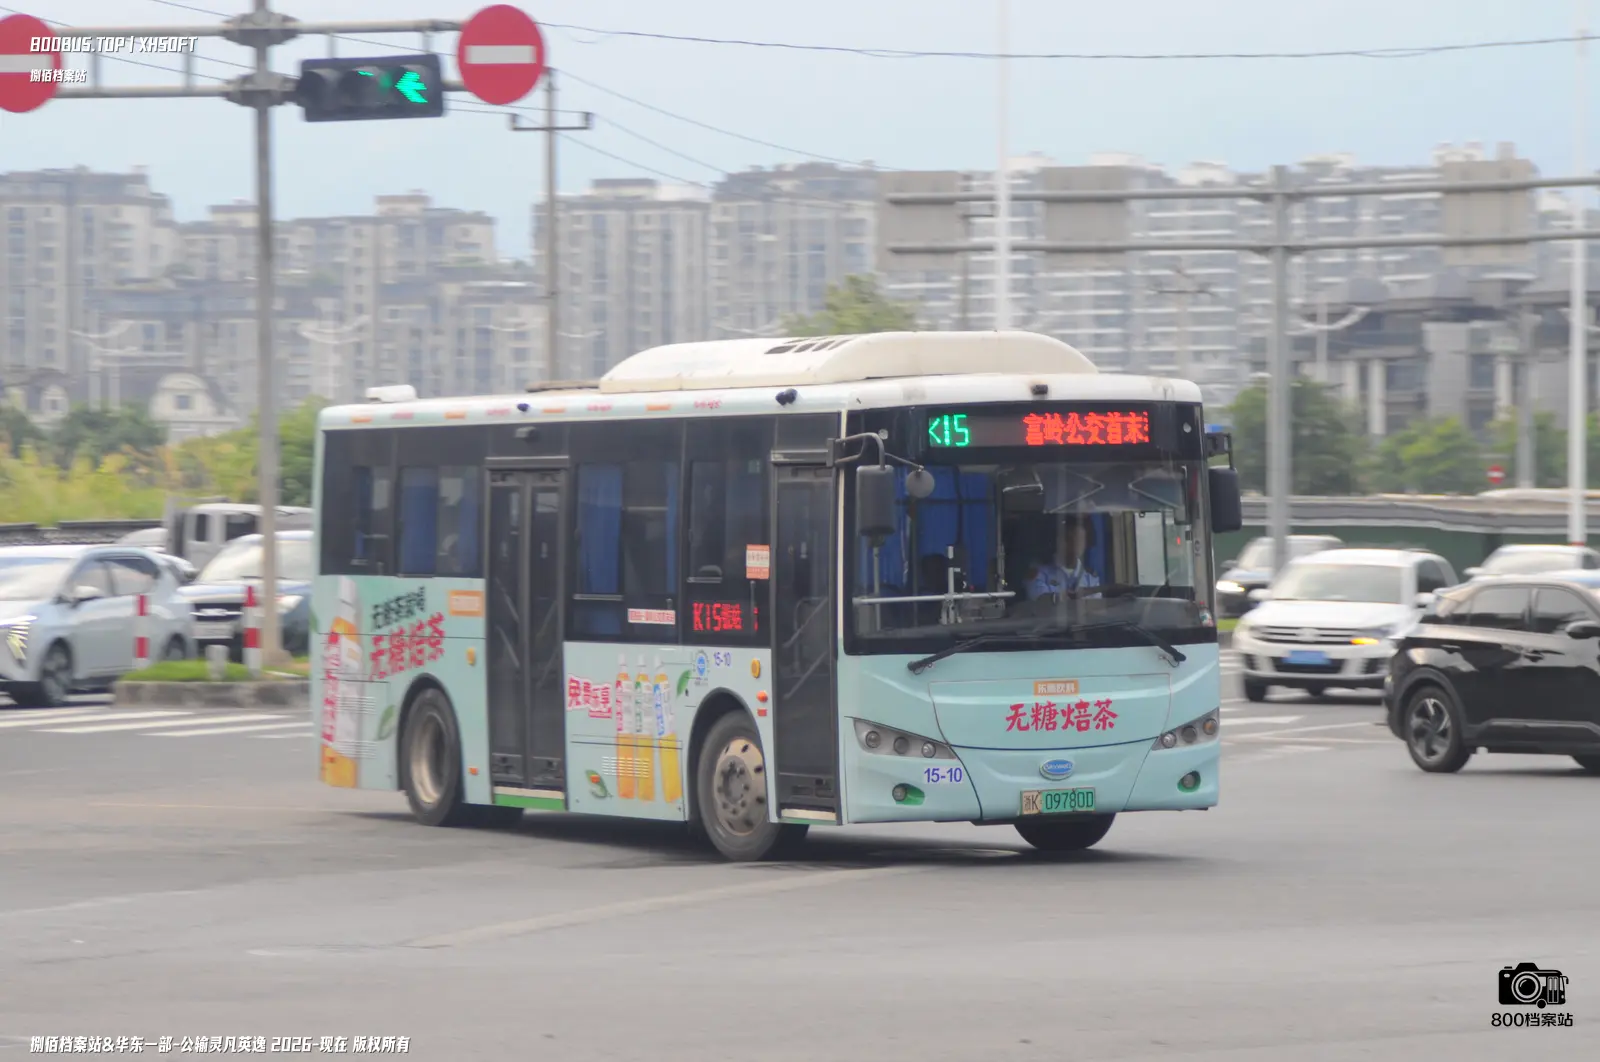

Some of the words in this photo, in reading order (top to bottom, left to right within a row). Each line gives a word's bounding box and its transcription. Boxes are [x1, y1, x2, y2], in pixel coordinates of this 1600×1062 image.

[1023, 411, 1150, 446] 富岭公交首末
[692, 603, 721, 631] K15
[1006, 698, 1118, 732] 无糖焙茶
[924, 767, 963, 783] 15-10
